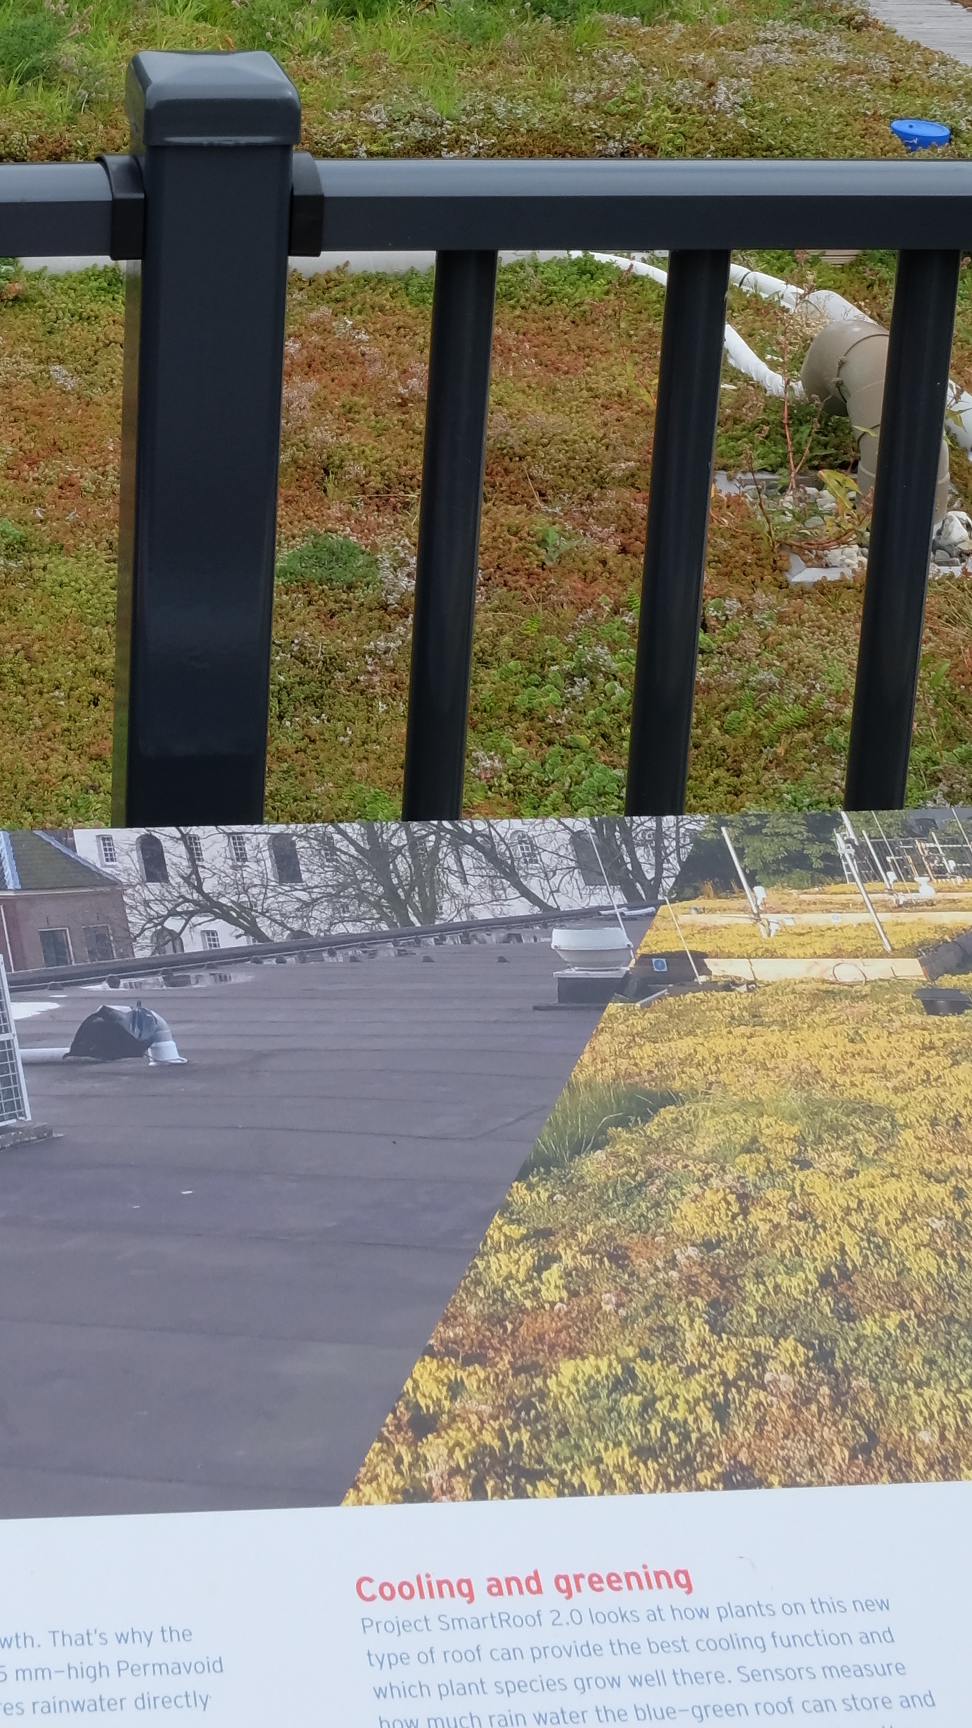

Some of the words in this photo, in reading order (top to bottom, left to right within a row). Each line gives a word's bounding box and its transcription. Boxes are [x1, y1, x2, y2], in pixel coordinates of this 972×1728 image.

[356, 1573, 475, 1604] Cooling
[487, 1569, 543, 1597] and
[554, 1564, 693, 1600] greening
[361, 1615, 432, 1637] Project
[438, 1610, 542, 1631] SmartRoof
[550, 1608, 584, 1628] 2.0
[589, 1607, 640, 1624] looks
[647, 1605, 665, 1622] at
[670, 1605, 709, 1620] how
[716, 1601, 775, 1622] plants
[782, 1603, 806, 1615] on
[810, 1597, 847, 1614] this
[852, 1599, 889, 1612] new
[48, 1629, 108, 1647] That's
[115, 1627, 153, 1647] why
[161, 1626, 192, 1642] the
[367, 1650, 410, 1670] type
[418, 1647, 434, 1664] of
[443, 1645, 481, 1663] roof
[490, 1647, 524, 1661] can
[530, 1640, 603, 1663] provide
[609, 1639, 641, 1656] the
[647, 1636, 689, 1654] best
[696, 1633, 766, 1653] cooling
[771, 1629, 853, 1648] function
[859, 1627, 894, 1644] and
[117, 1656, 223, 1677] Permavoid
[373, 1681, 431, 1699] which
[438, 1678, 487, 1700] plant
[494, 1675, 567, 1697] species
[574, 1676, 620, 1694] grow
[628, 1669, 667, 1687] well
[672, 1669, 731, 1685] there.
[737, 1666, 816, 1683] Sensors
[822, 1662, 906, 1679] measure
[32, 1694, 126, 1714] rainwater
[135, 1691, 209, 1711] directly
[427, 1712, 482, 1728] much
[489, 1710, 527, 1728] rain
[533, 1707, 588, 1725] water
[595, 1705, 628, 1723] the
[755, 1697, 794, 1715] roof
[802, 1699, 837, 1713] can
[842, 1694, 892, 1711] store
[899, 1690, 935, 1708] and
